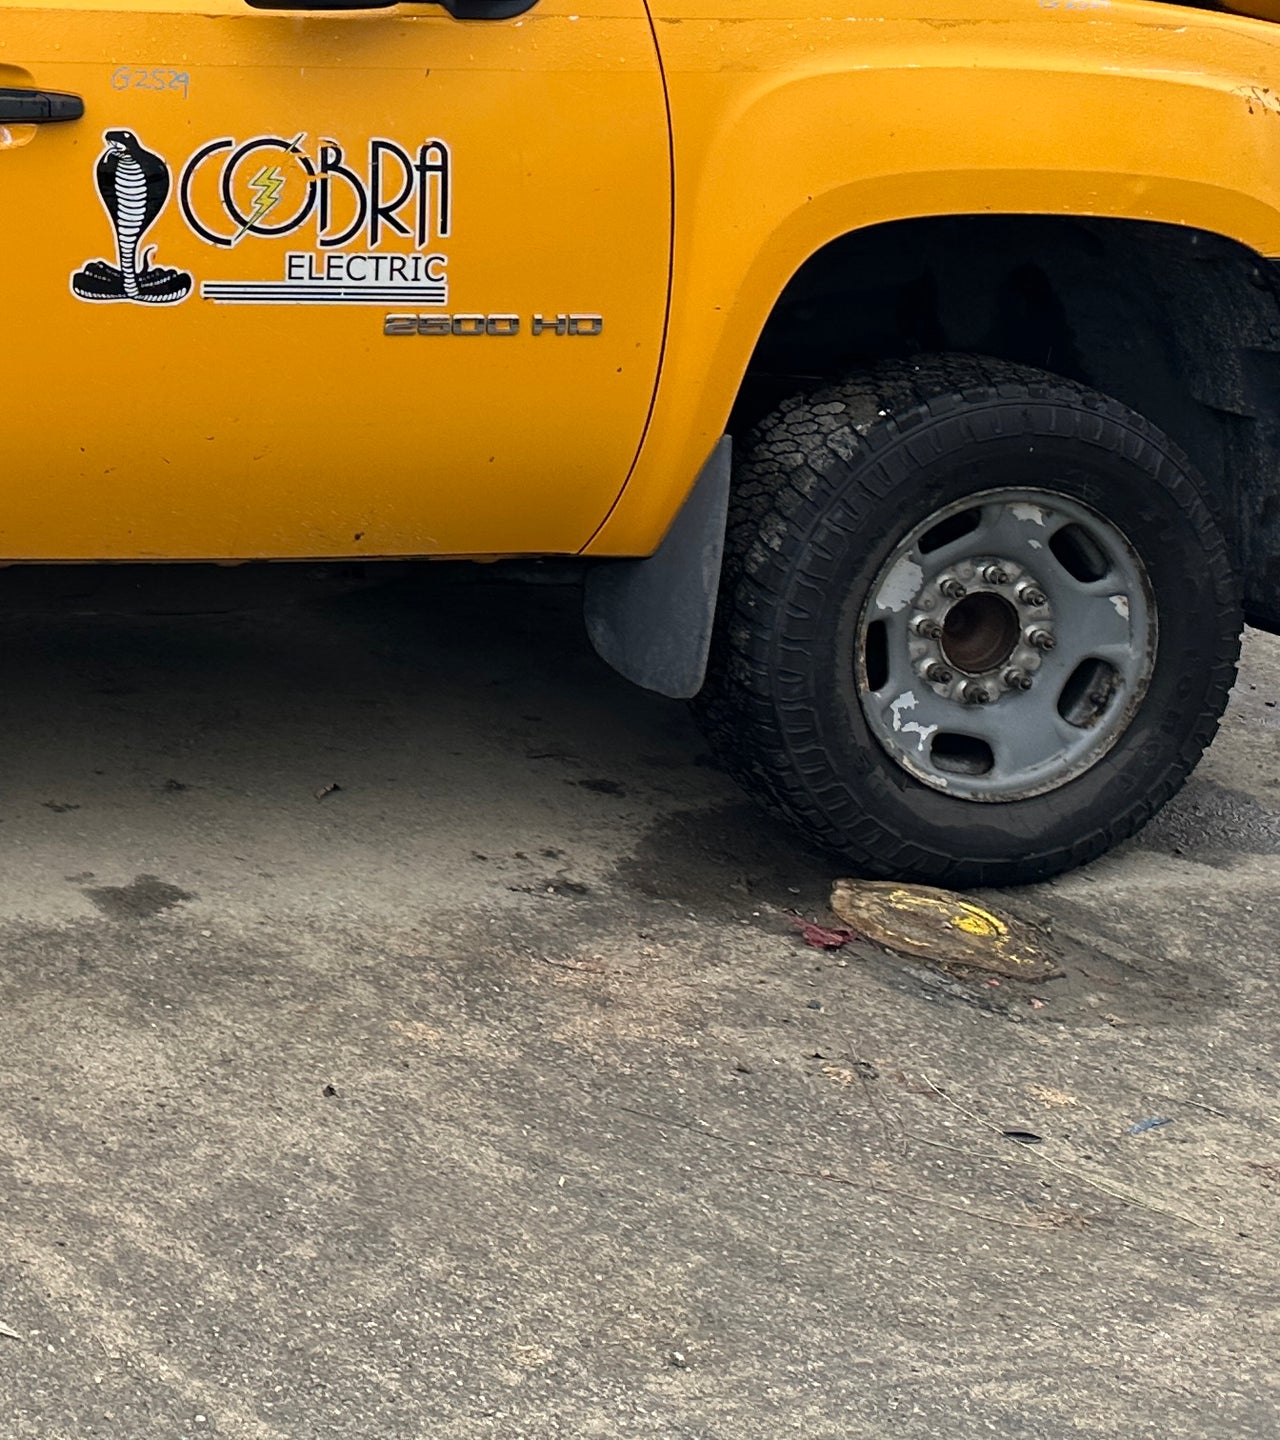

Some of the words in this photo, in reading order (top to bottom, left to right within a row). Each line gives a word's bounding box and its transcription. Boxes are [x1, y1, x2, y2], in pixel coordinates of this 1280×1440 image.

[110, 65, 190, 100] G2529
[178, 133, 451, 250] COBRA
[286, 254, 447, 282] ELECTRIC
[383, 312, 519, 336] 2500
[531, 313, 603, 336] HD
